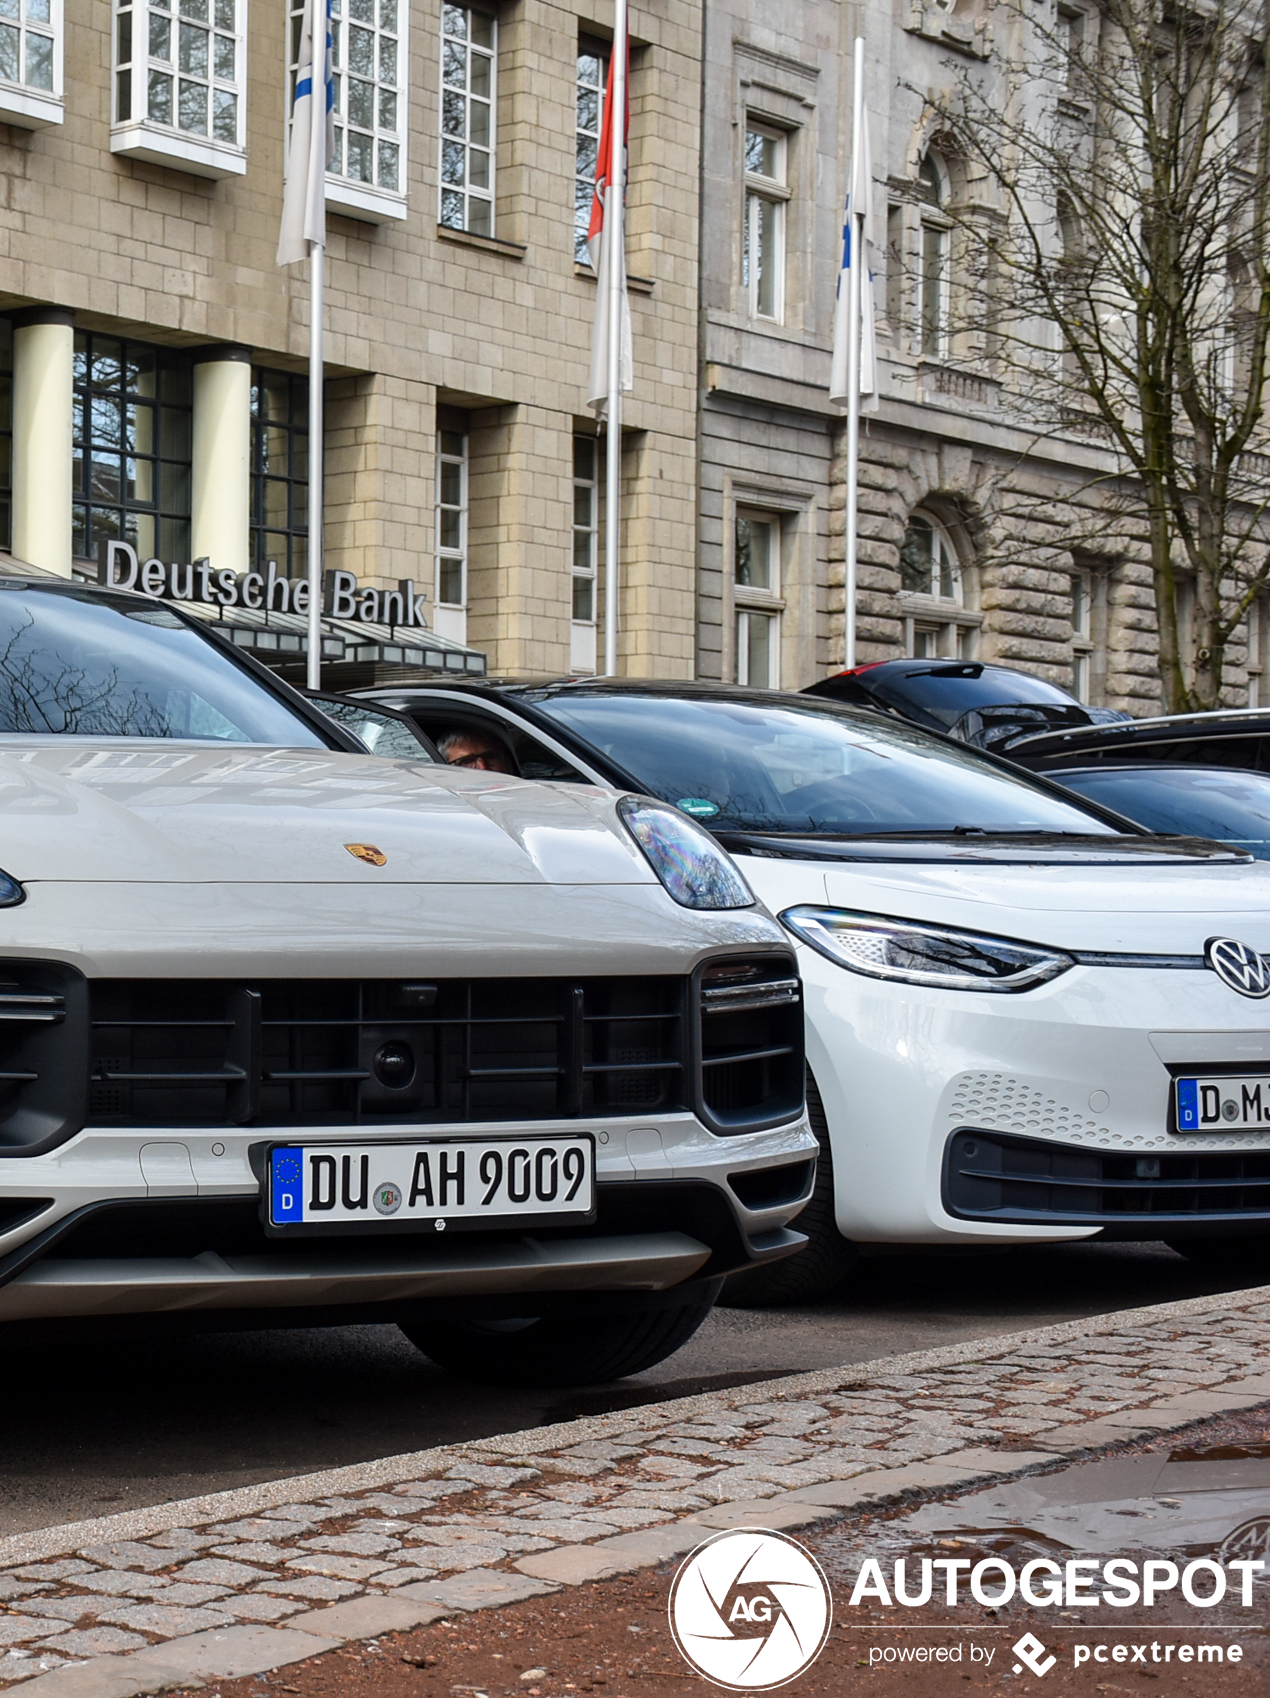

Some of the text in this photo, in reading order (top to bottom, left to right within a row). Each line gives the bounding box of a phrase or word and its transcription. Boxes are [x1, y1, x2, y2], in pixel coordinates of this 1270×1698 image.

[99, 539, 427, 627] Deutsche Bank
[1184, 1109, 1193, 1122] D
[1200, 1085, 1220, 1123] D
[308, 1154, 369, 1211] DU
[408, 1150, 466, 1207] AH
[479, 1147, 585, 1206] 9009
[282, 1193, 293, 1210] D
